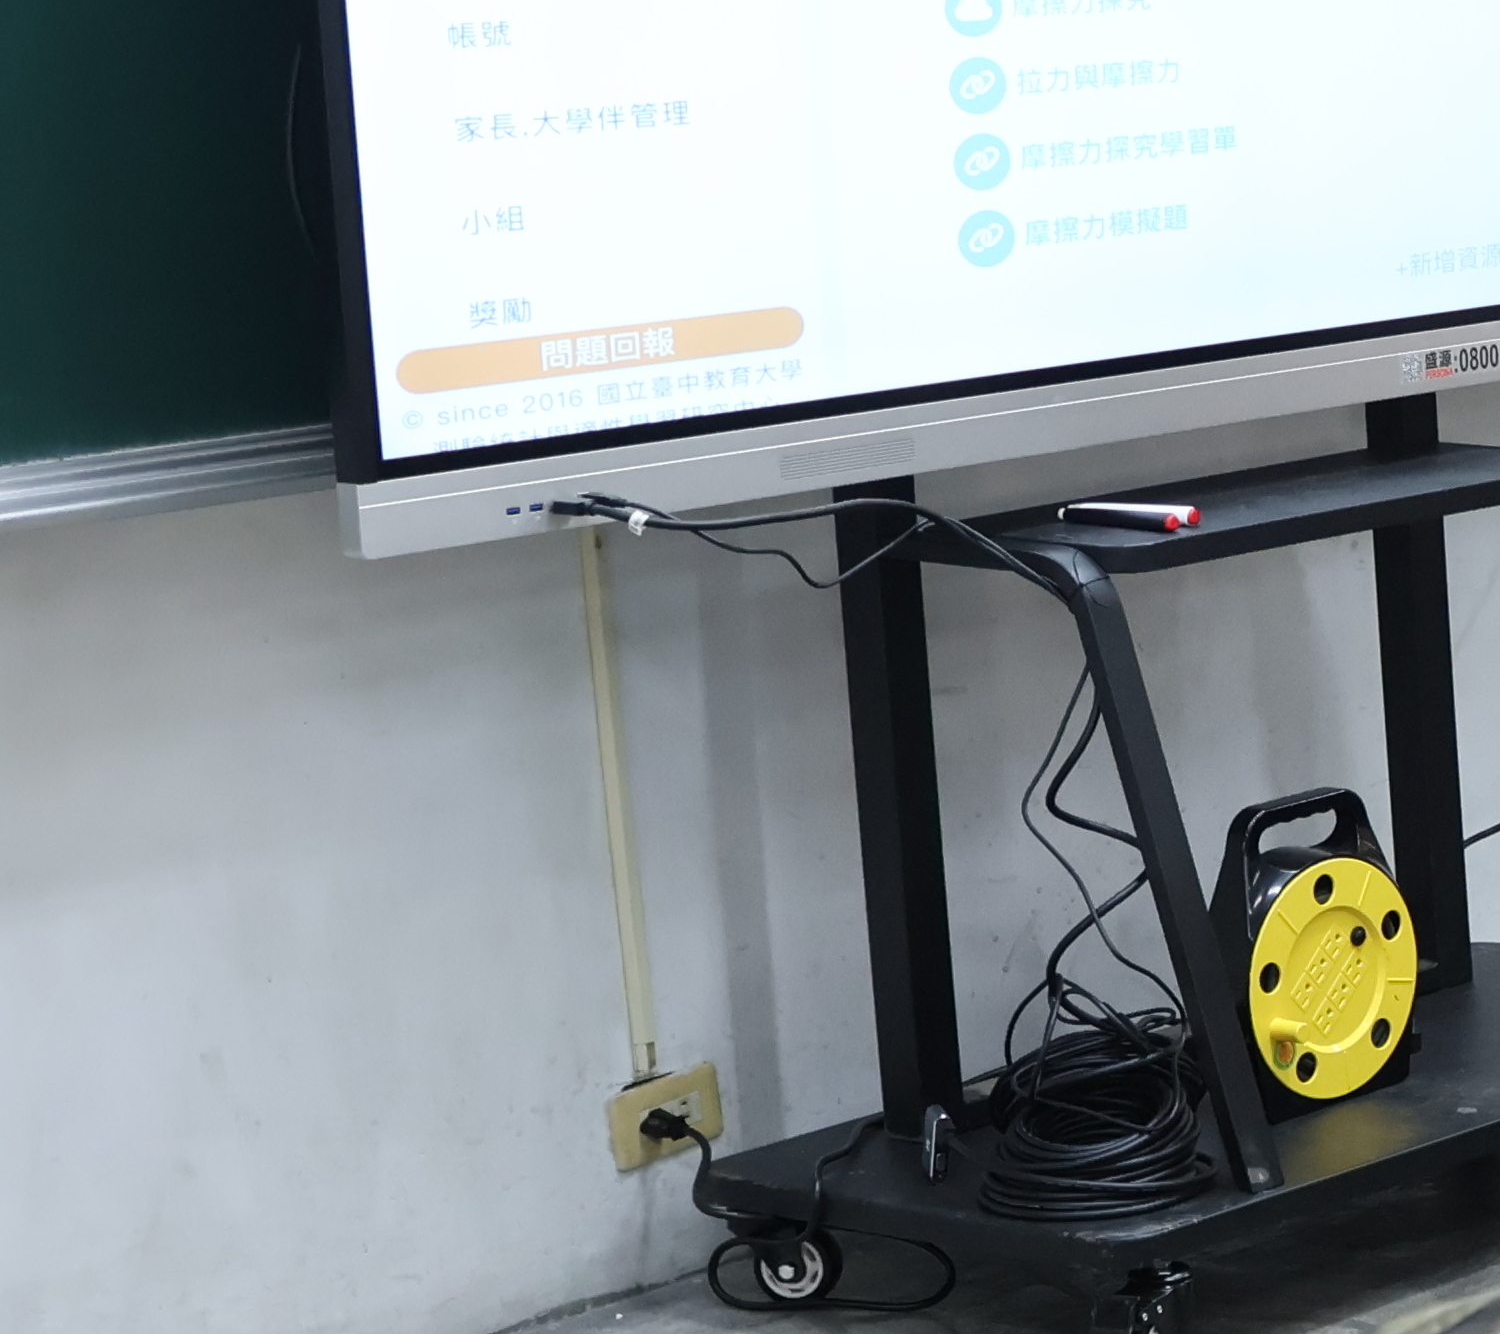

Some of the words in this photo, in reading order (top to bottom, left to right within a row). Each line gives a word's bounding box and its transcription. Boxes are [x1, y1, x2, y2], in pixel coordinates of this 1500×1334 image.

[447, 21, 512, 49] 帳號
[1017, 58, 1181, 96] 拉力與摩擦力
[1020, 124, 1239, 172] 摩擦力探究學習單
[461, 204, 526, 237] 小組
[1025, 203, 1190, 248] 摩擦力模擬題
[468, 297, 533, 330] 獎勵
[539, 326, 676, 373] 問題回報
[437, 401, 510, 427] since
[521, 387, 585, 416] 2016
[596, 357, 804, 406] 國立臺中教育大學
